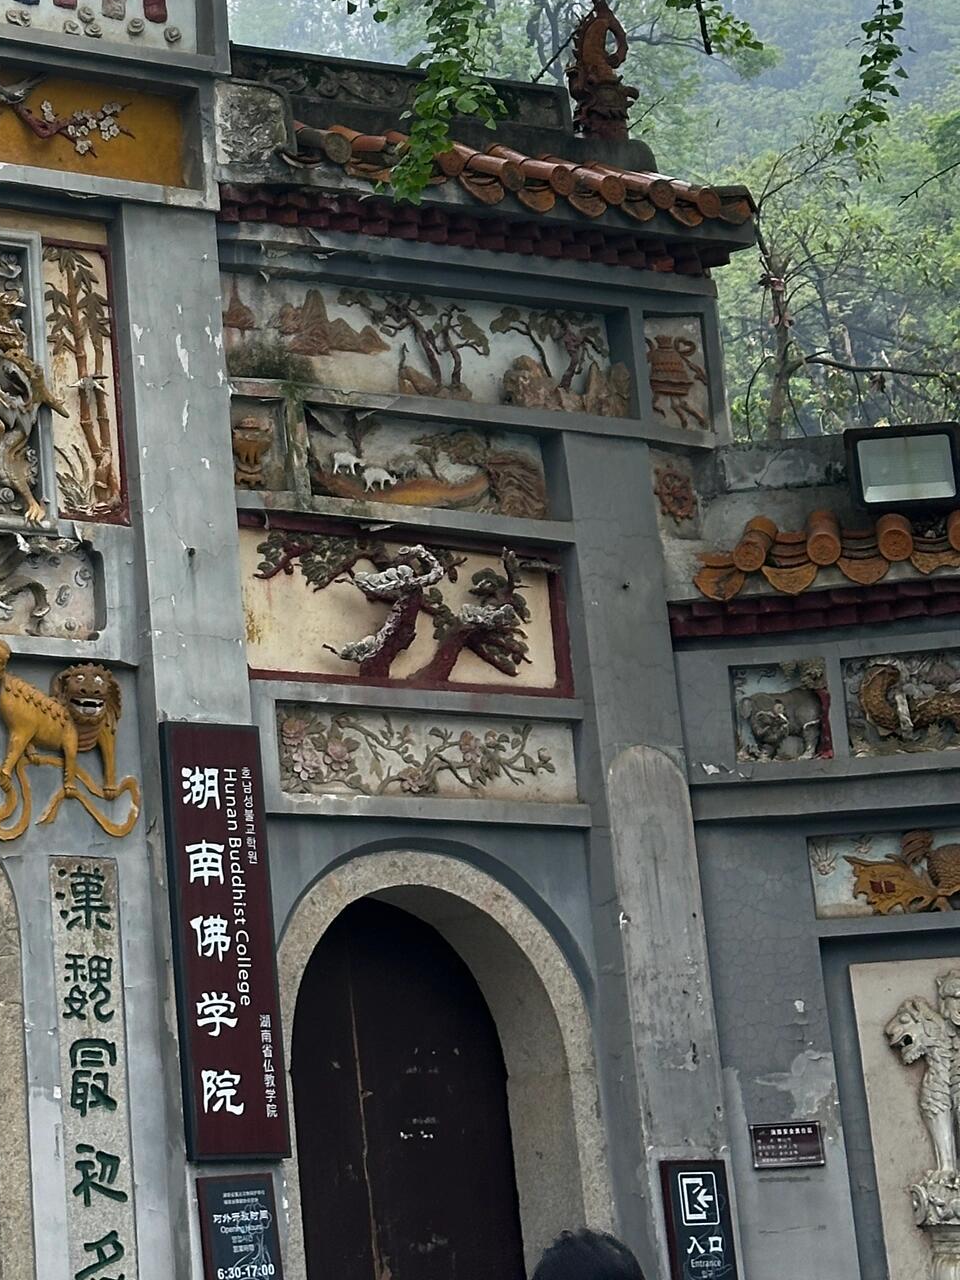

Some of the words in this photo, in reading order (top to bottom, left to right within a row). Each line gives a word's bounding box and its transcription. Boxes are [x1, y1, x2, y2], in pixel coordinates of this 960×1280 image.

[223, 768, 238, 831] Hunan
[228, 837, 247, 925] Buddhist
[181, 766, 245, 1116] 湖南佛学院
[235, 930, 252, 1006] College
[217, 1263, 275, 1280] 6:30-17:00
[686, 1236, 723, 1254] 入口
[690, 1258, 722, 1268] Entrance
